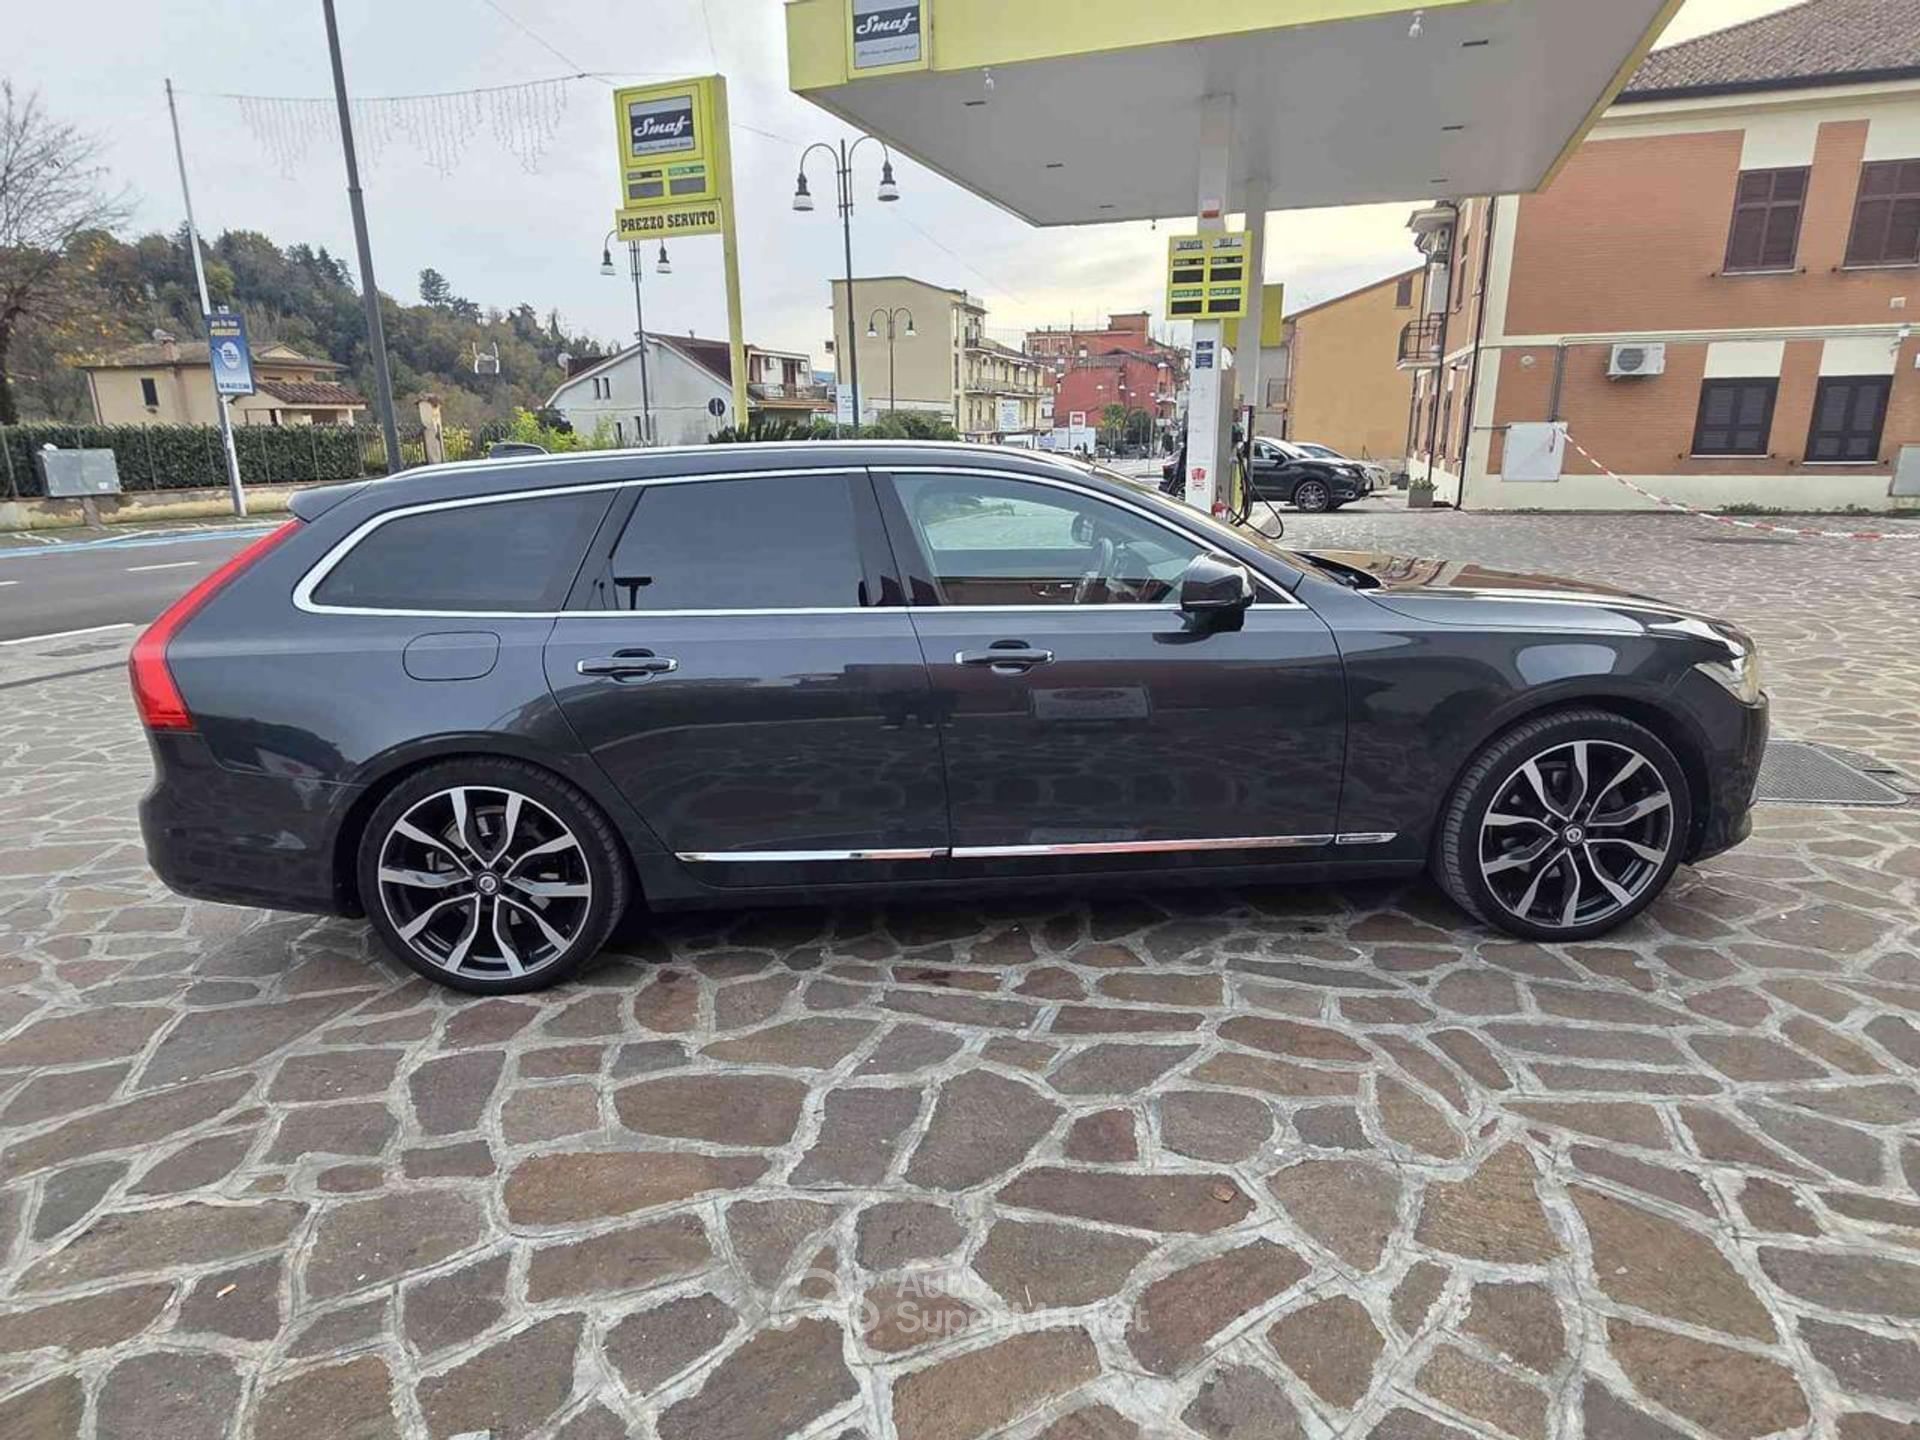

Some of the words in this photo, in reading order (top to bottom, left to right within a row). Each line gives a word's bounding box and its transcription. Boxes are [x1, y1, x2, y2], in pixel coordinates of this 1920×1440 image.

[856, 12, 917, 34] Smaf
[633, 115, 691, 136] Smaf
[620, 218, 664, 232] PREZZO
[667, 210, 716, 228] SERVITO
